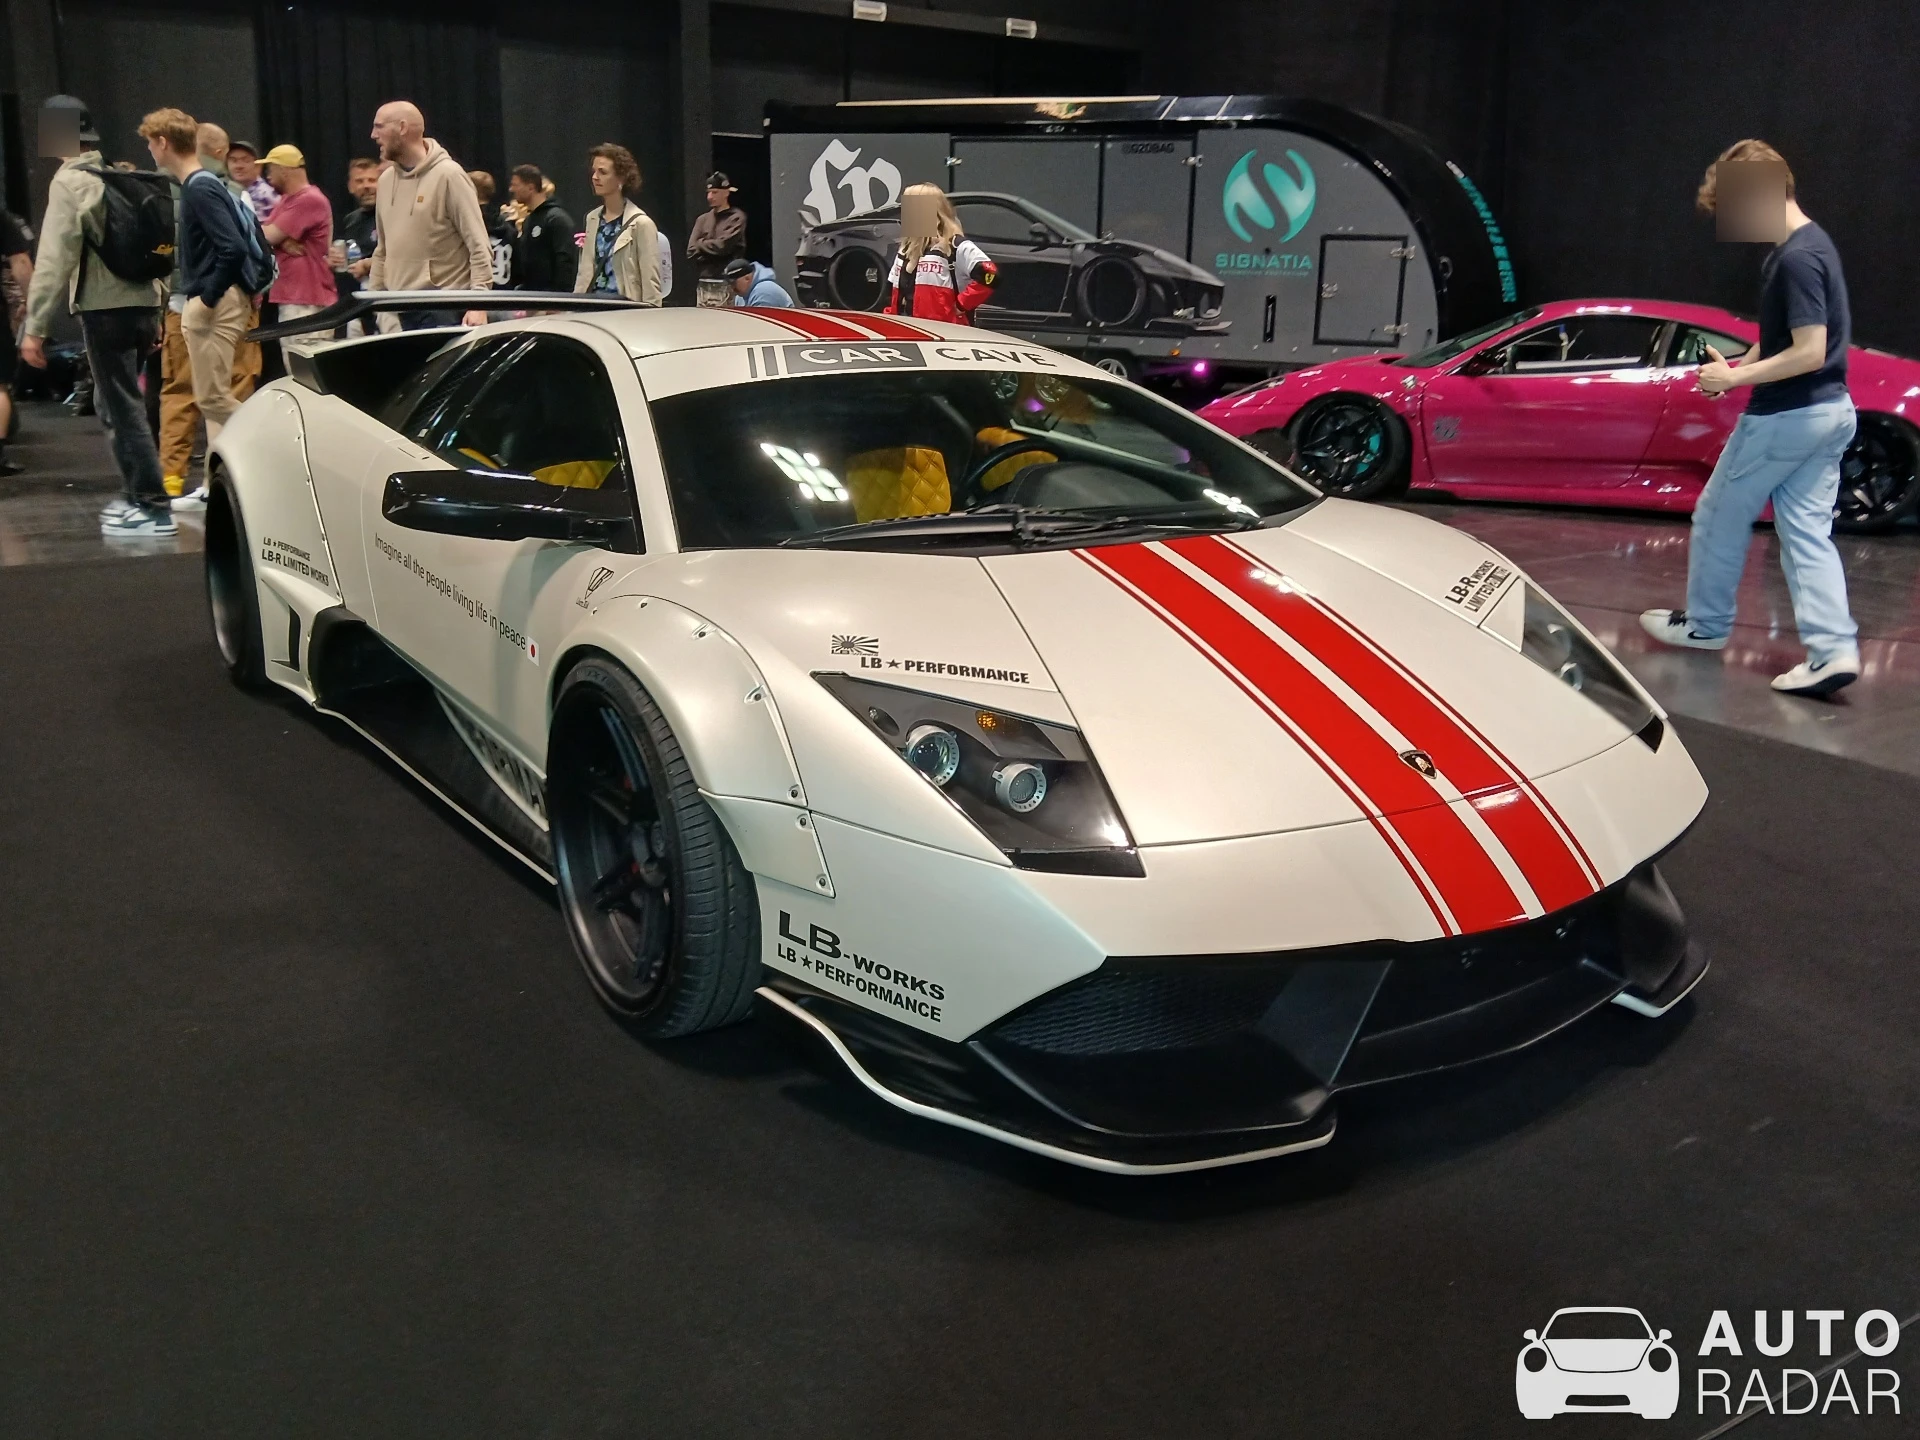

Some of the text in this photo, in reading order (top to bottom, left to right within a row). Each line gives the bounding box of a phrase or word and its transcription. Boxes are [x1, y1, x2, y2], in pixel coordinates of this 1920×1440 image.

[1215, 253, 1313, 269] SIGNATIA
[799, 347, 1058, 368] CAR CAVE
[262, 548, 282, 566] LB-R
[283, 555, 310, 576] LIMITED
[263, 537, 311, 562] LB PERFORMANCE
[374, 532, 526, 650] Imagine all the people living life in peace
[1444, 576, 1479, 605] LB-R
[860, 656, 1030, 684] LB PERFORMANCE
[777, 943, 942, 1023] LB PERFORMANCE
